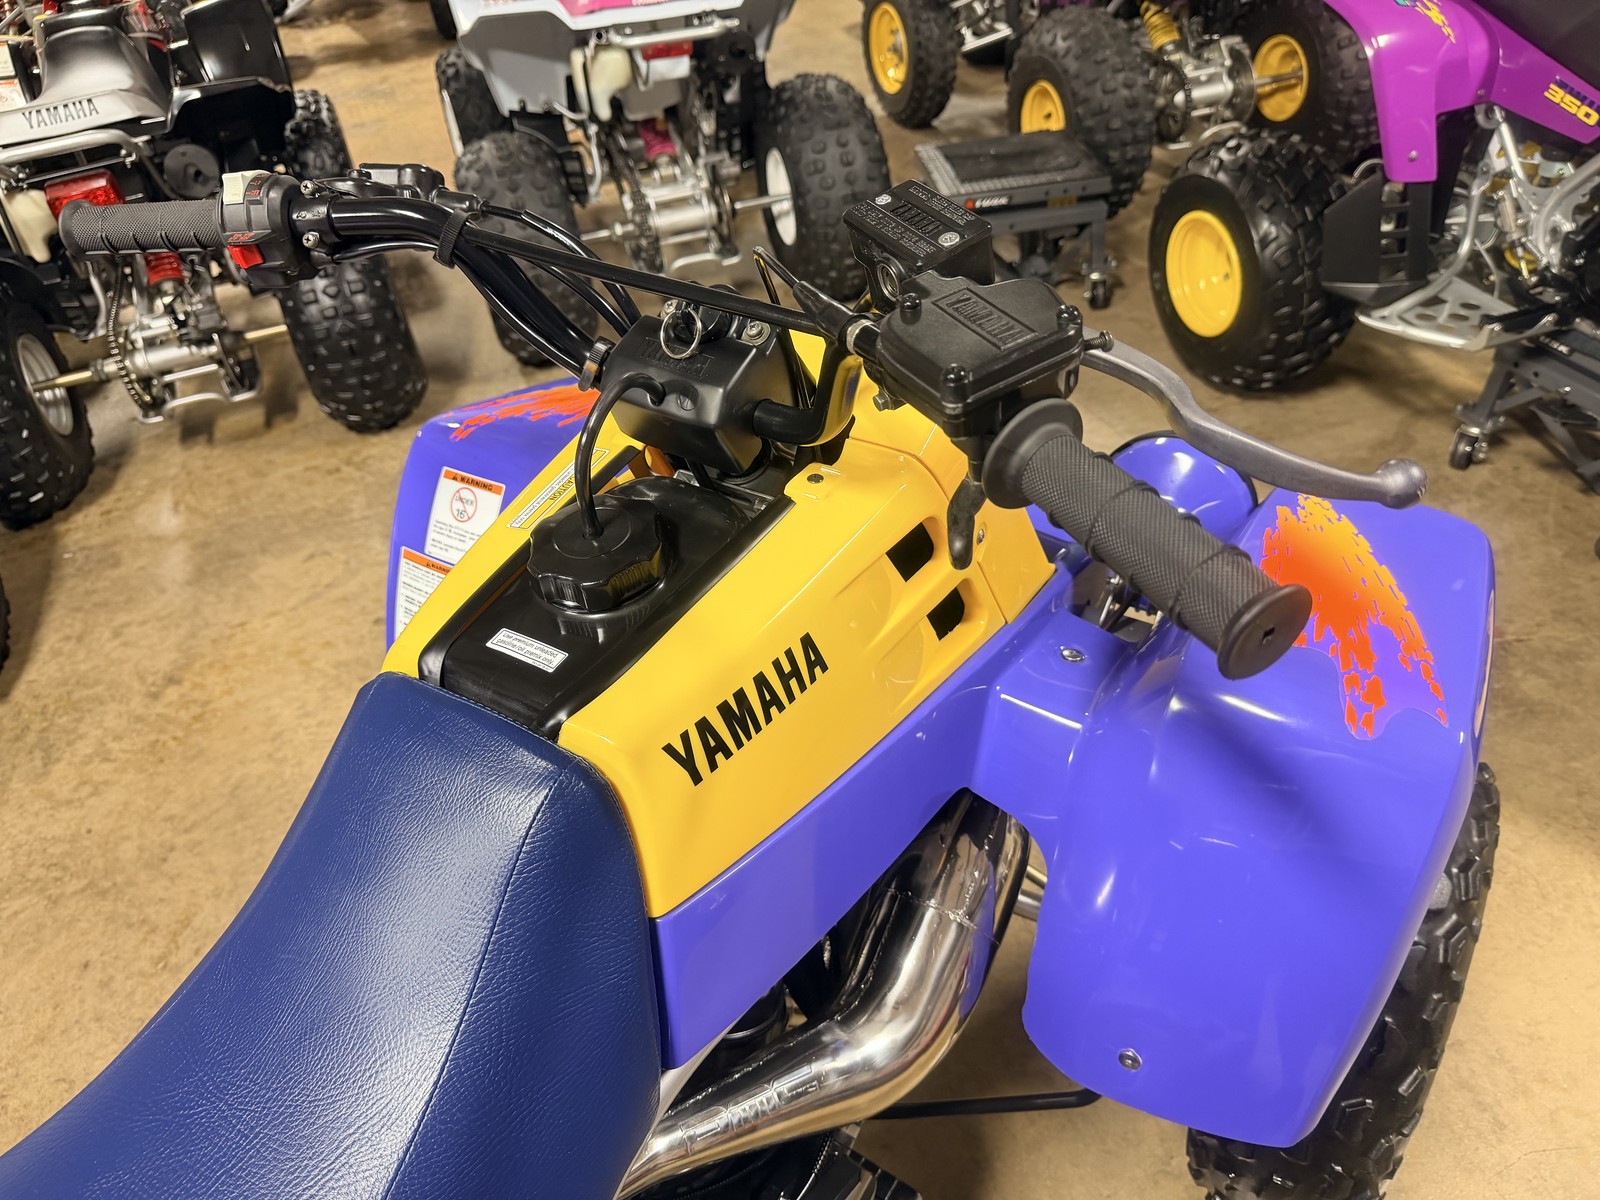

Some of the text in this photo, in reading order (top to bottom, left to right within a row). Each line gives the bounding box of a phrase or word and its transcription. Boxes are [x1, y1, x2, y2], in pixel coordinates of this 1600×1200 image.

[22, 98, 99, 129] YAMAHA
[1543, 83, 1600, 127] 350
[945, 294, 1025, 345] YAMAHA
[460, 475, 493, 491] WARNING
[496, 638, 525, 652] gasoline/oil
[523, 649, 542, 660] premix
[502, 632, 559, 658] Use premium unleaded
[661, 632, 829, 787] YAMAHA
